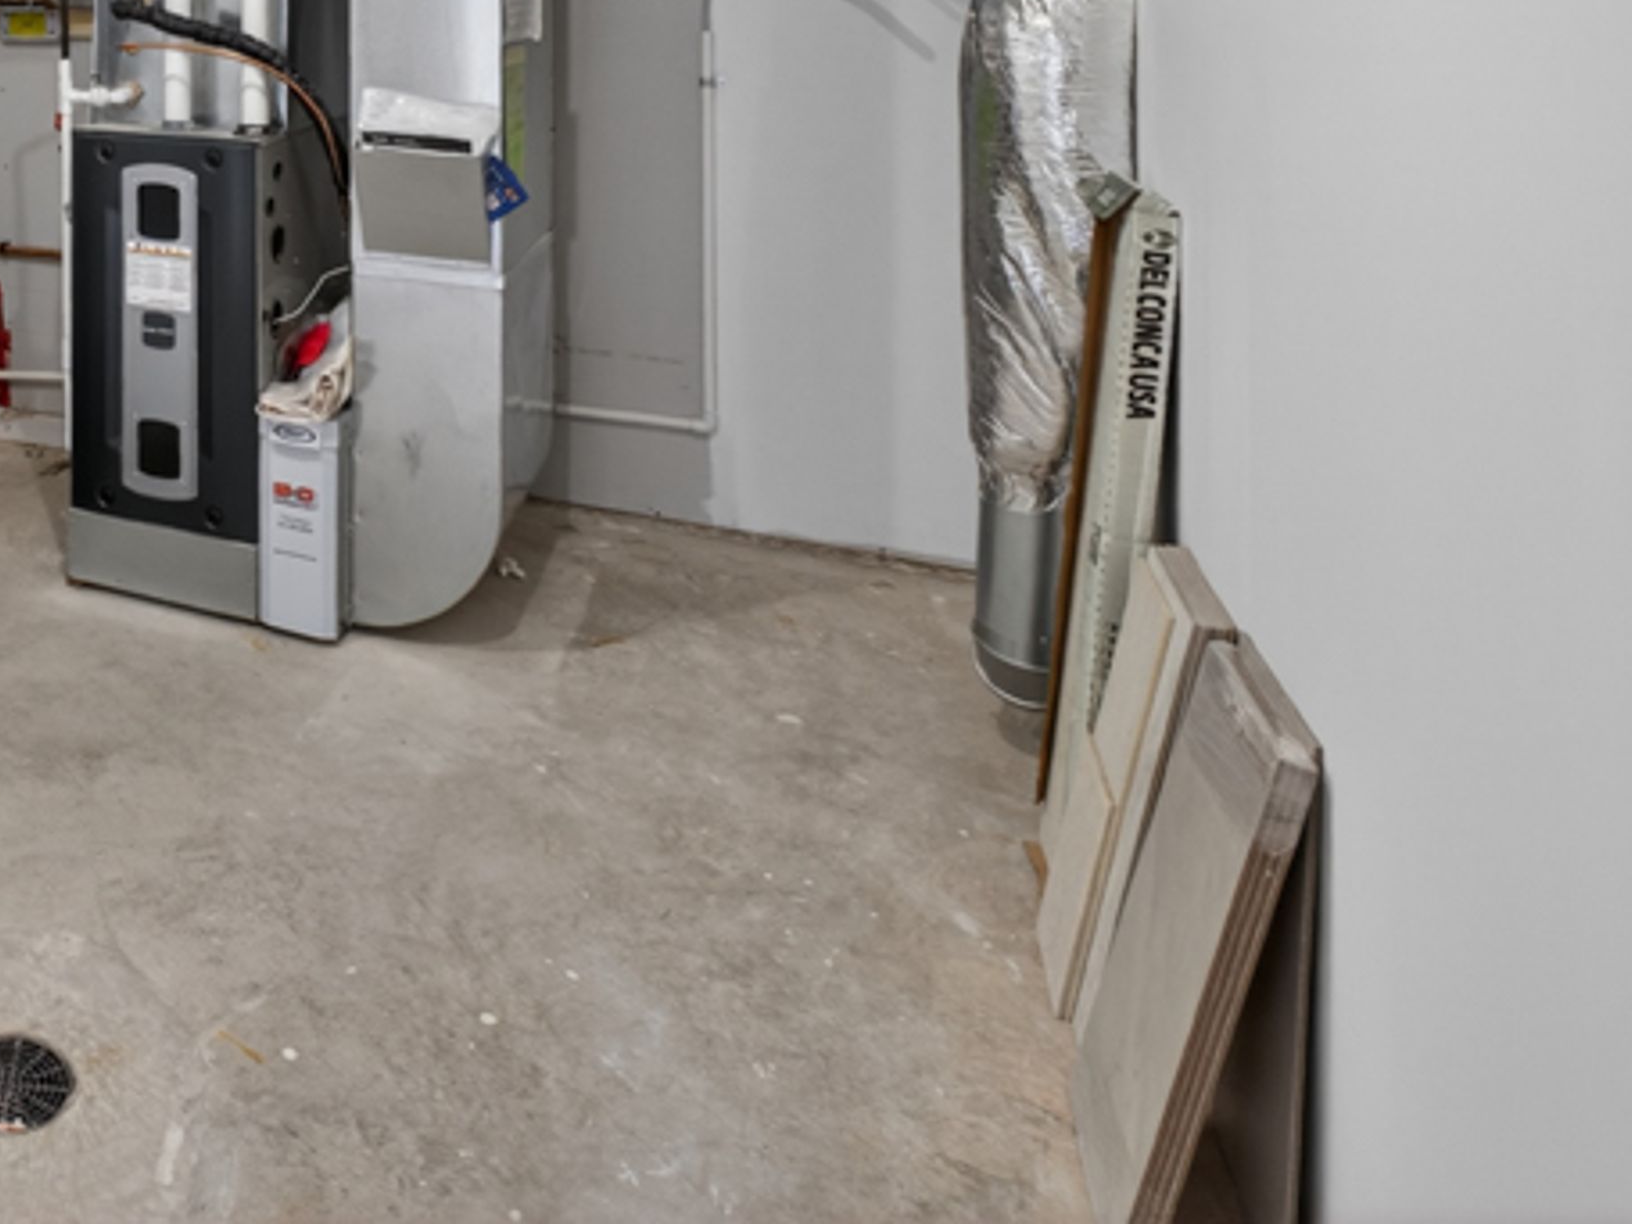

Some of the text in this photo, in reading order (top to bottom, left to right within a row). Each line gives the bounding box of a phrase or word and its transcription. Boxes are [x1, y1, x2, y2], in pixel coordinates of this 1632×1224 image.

[1127, 251, 1171, 419] DEL CONCA USA
